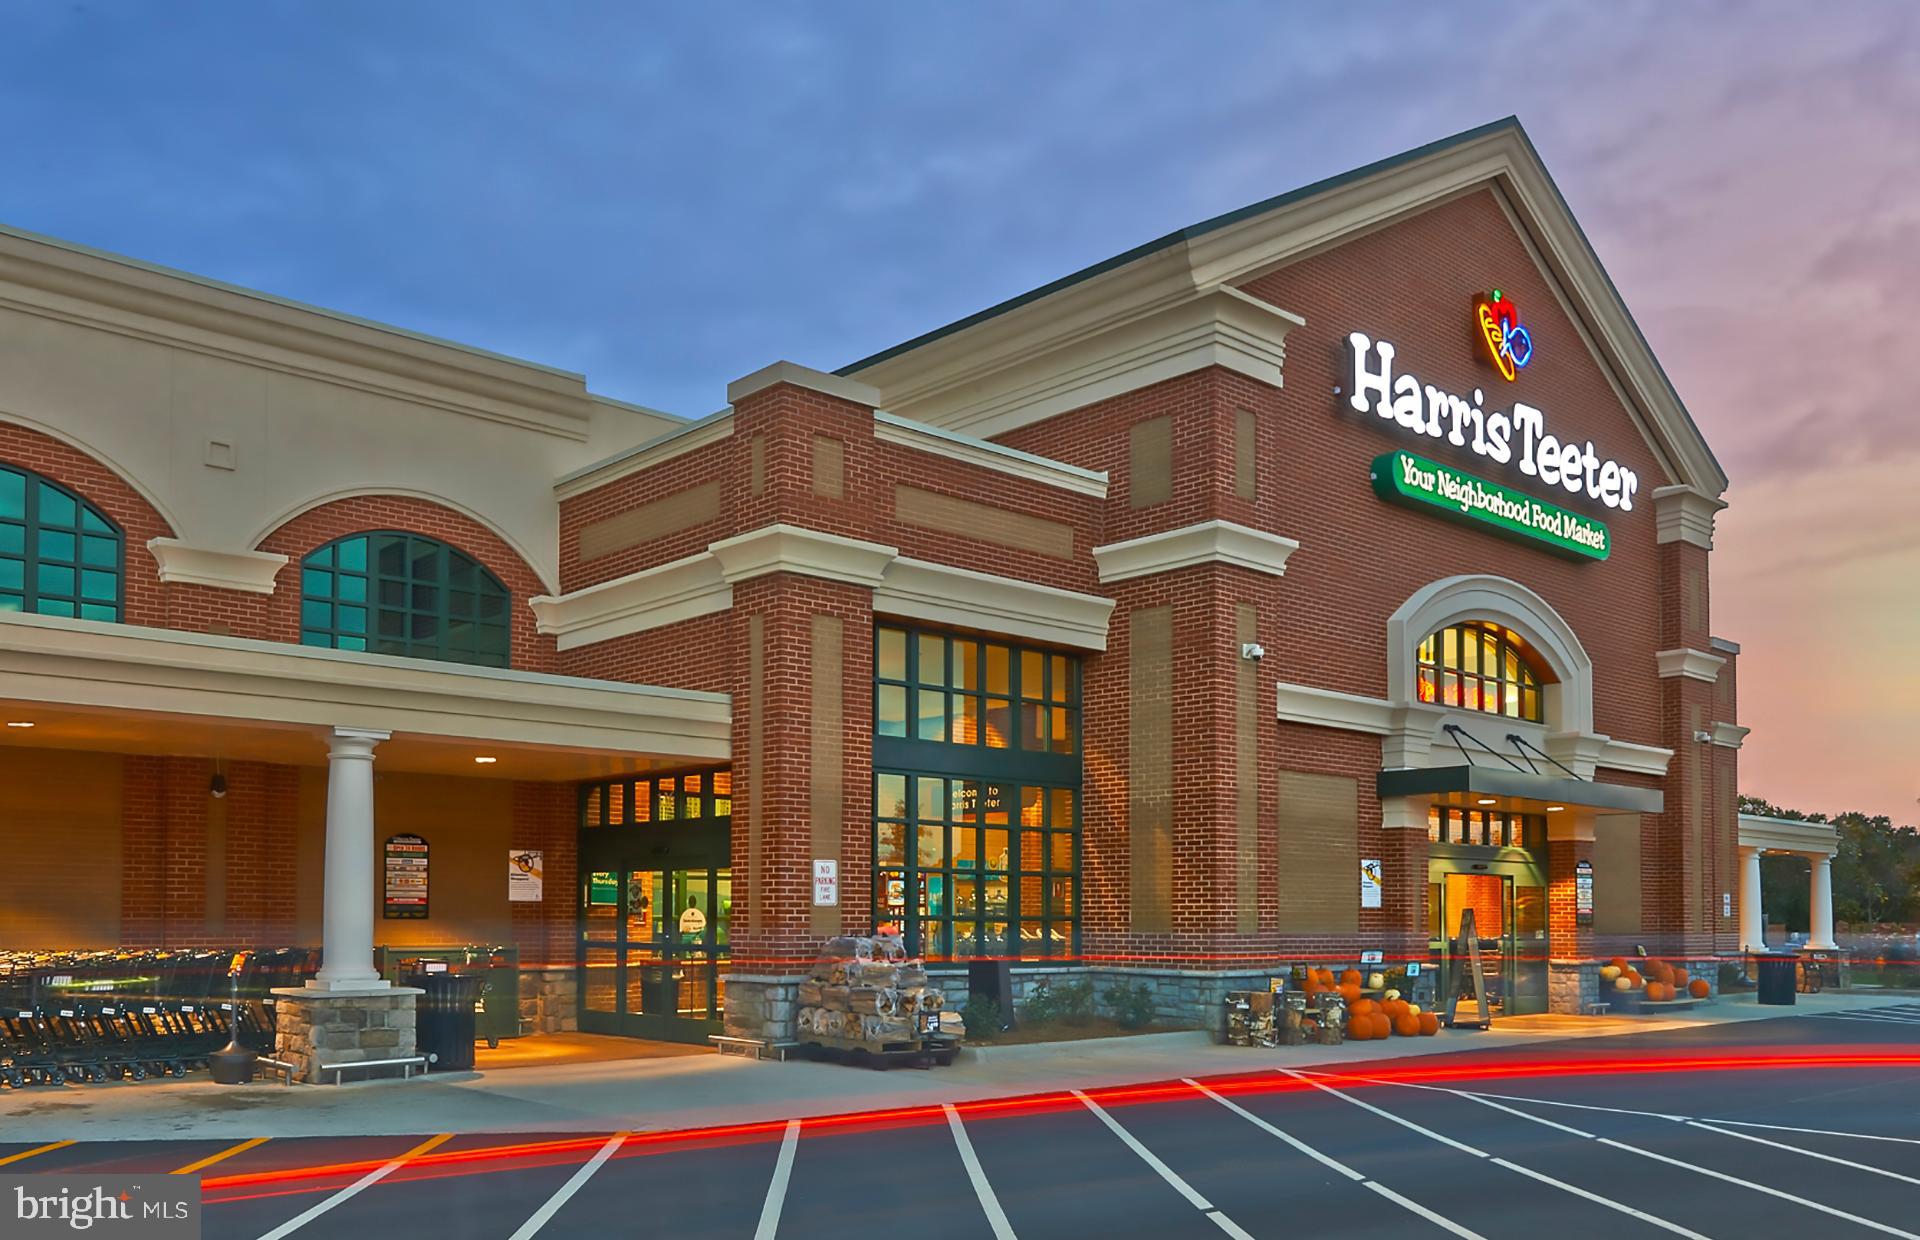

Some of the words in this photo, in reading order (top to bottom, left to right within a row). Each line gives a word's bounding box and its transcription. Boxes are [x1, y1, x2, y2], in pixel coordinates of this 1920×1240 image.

[1350, 332, 1511, 463] Harris
[1513, 402, 1637, 511] Teeter
[1401, 454, 1435, 492] Your
[1437, 470, 1530, 526] Neighborhood
[1531, 503, 1562, 536] Food
[1563, 515, 1605, 550] Market
[815, 877, 836, 885] PARKING
[820, 865, 830, 874] NO
